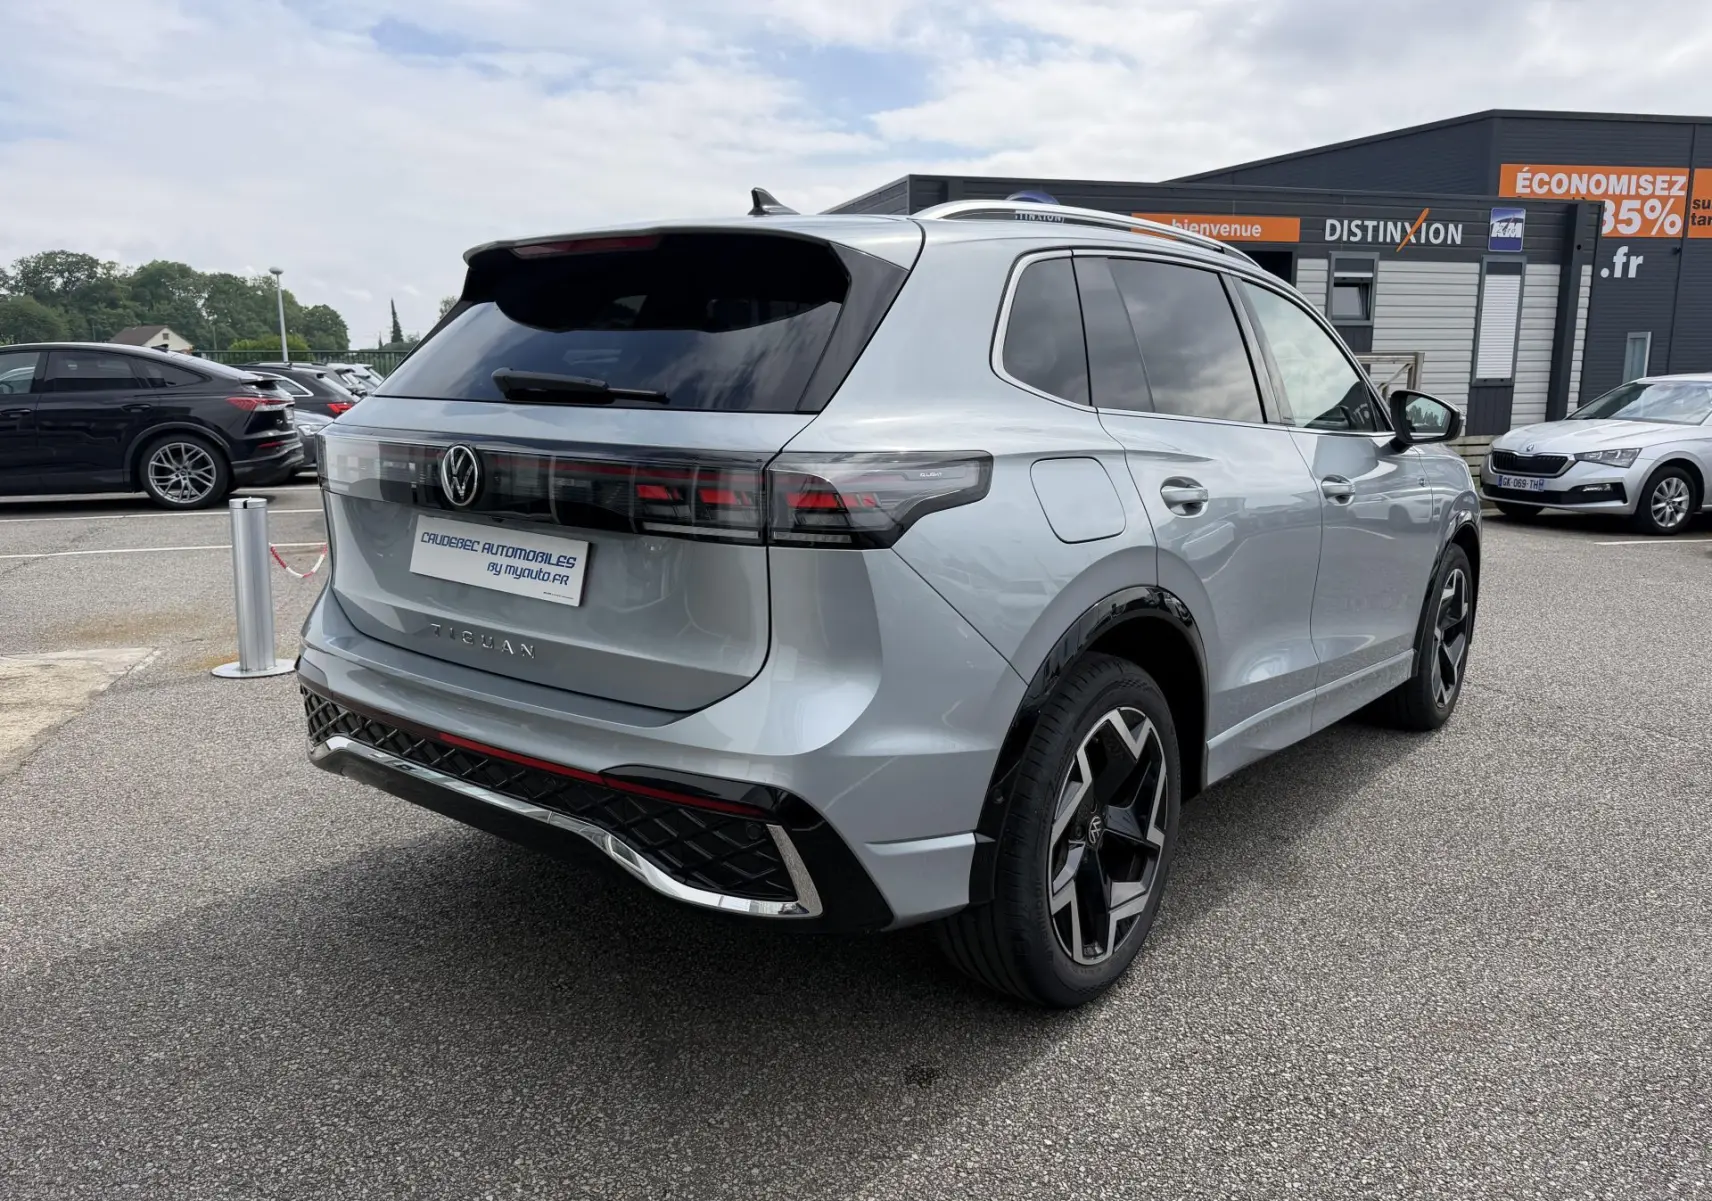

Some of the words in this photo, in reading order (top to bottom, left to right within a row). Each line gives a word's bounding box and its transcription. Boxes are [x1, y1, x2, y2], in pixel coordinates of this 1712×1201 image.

[1515, 167, 1687, 196] ÉCONOMISEZ
[1171, 219, 1261, 237] bienvenue
[1324, 208, 1463, 252] DISTINXION
[421, 532, 480, 553] CAUDEBEC
[481, 541, 577, 569] AUTOMOBILES
[430, 623, 535, 659] TIGUAN
